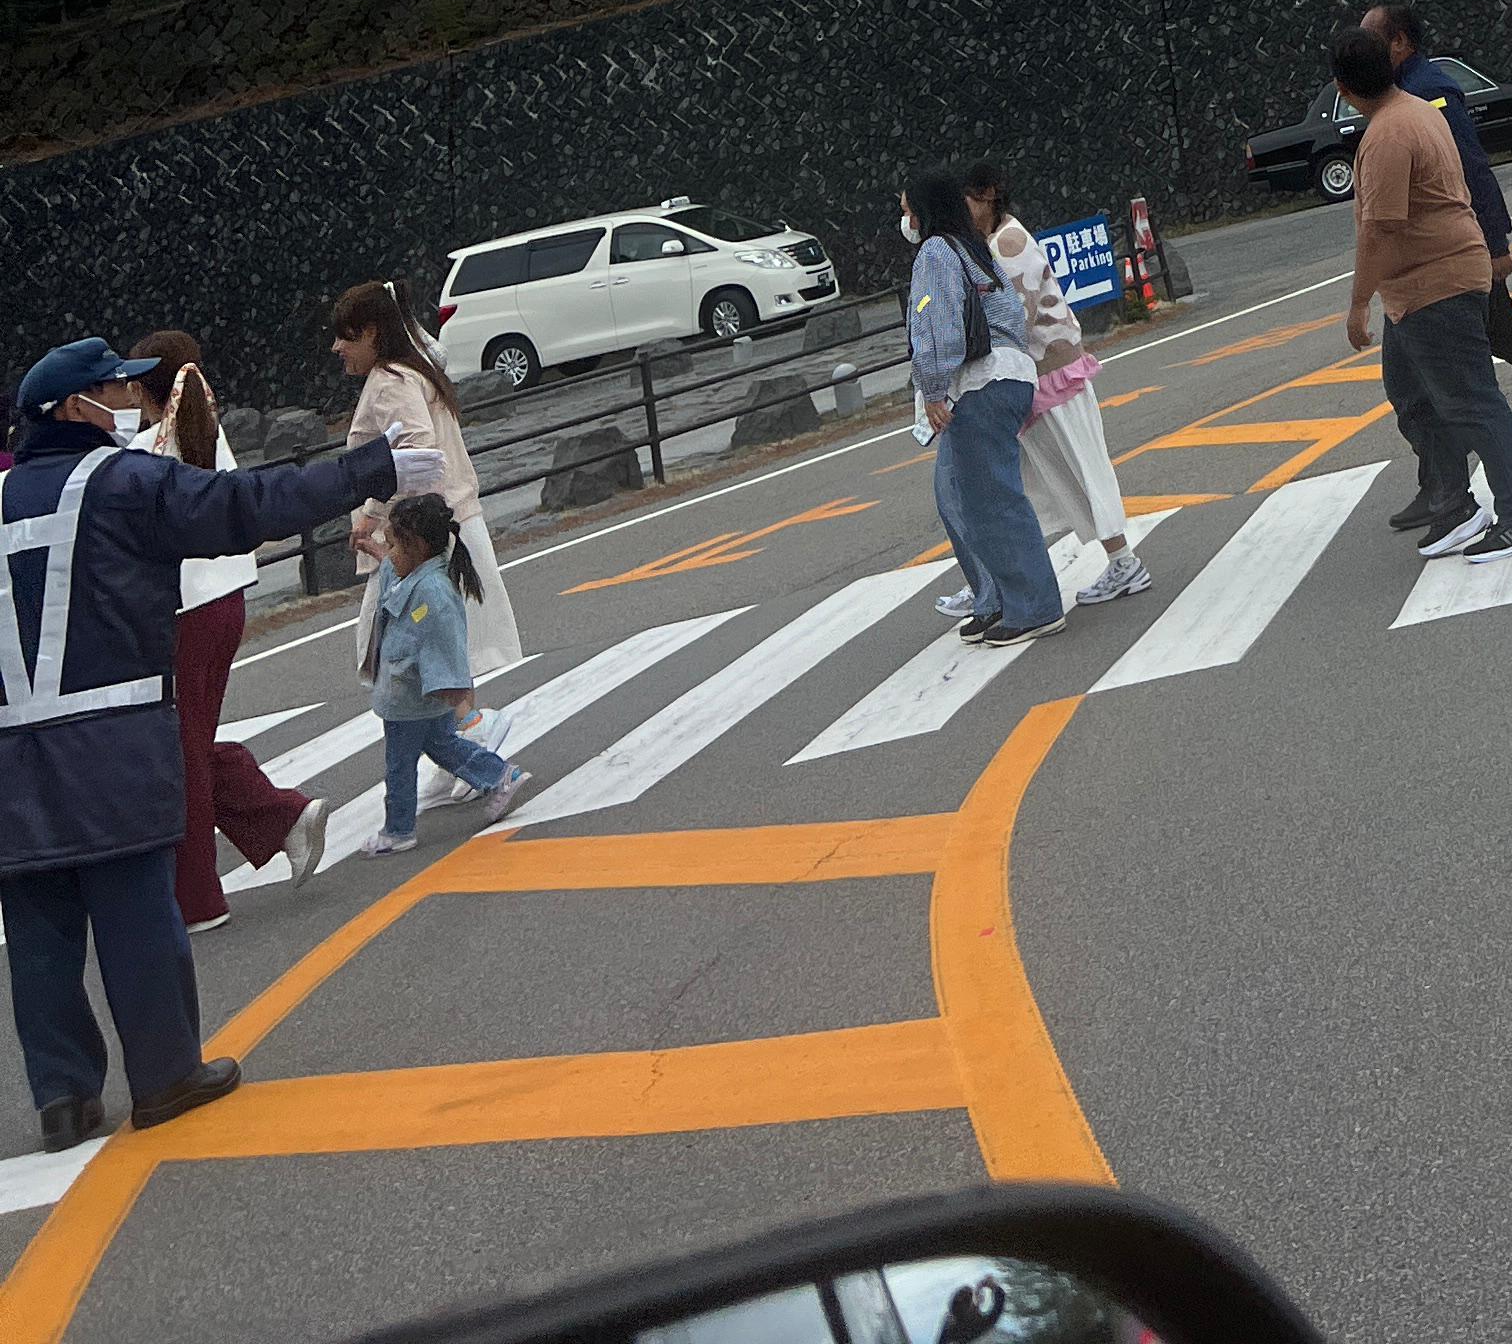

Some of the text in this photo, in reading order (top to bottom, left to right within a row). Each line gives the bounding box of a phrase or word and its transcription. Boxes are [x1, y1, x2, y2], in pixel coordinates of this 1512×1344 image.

[1065, 223, 1109, 255] 駐車場
[1045, 241, 1062, 274] P
[1069, 250, 1114, 274] Parking
